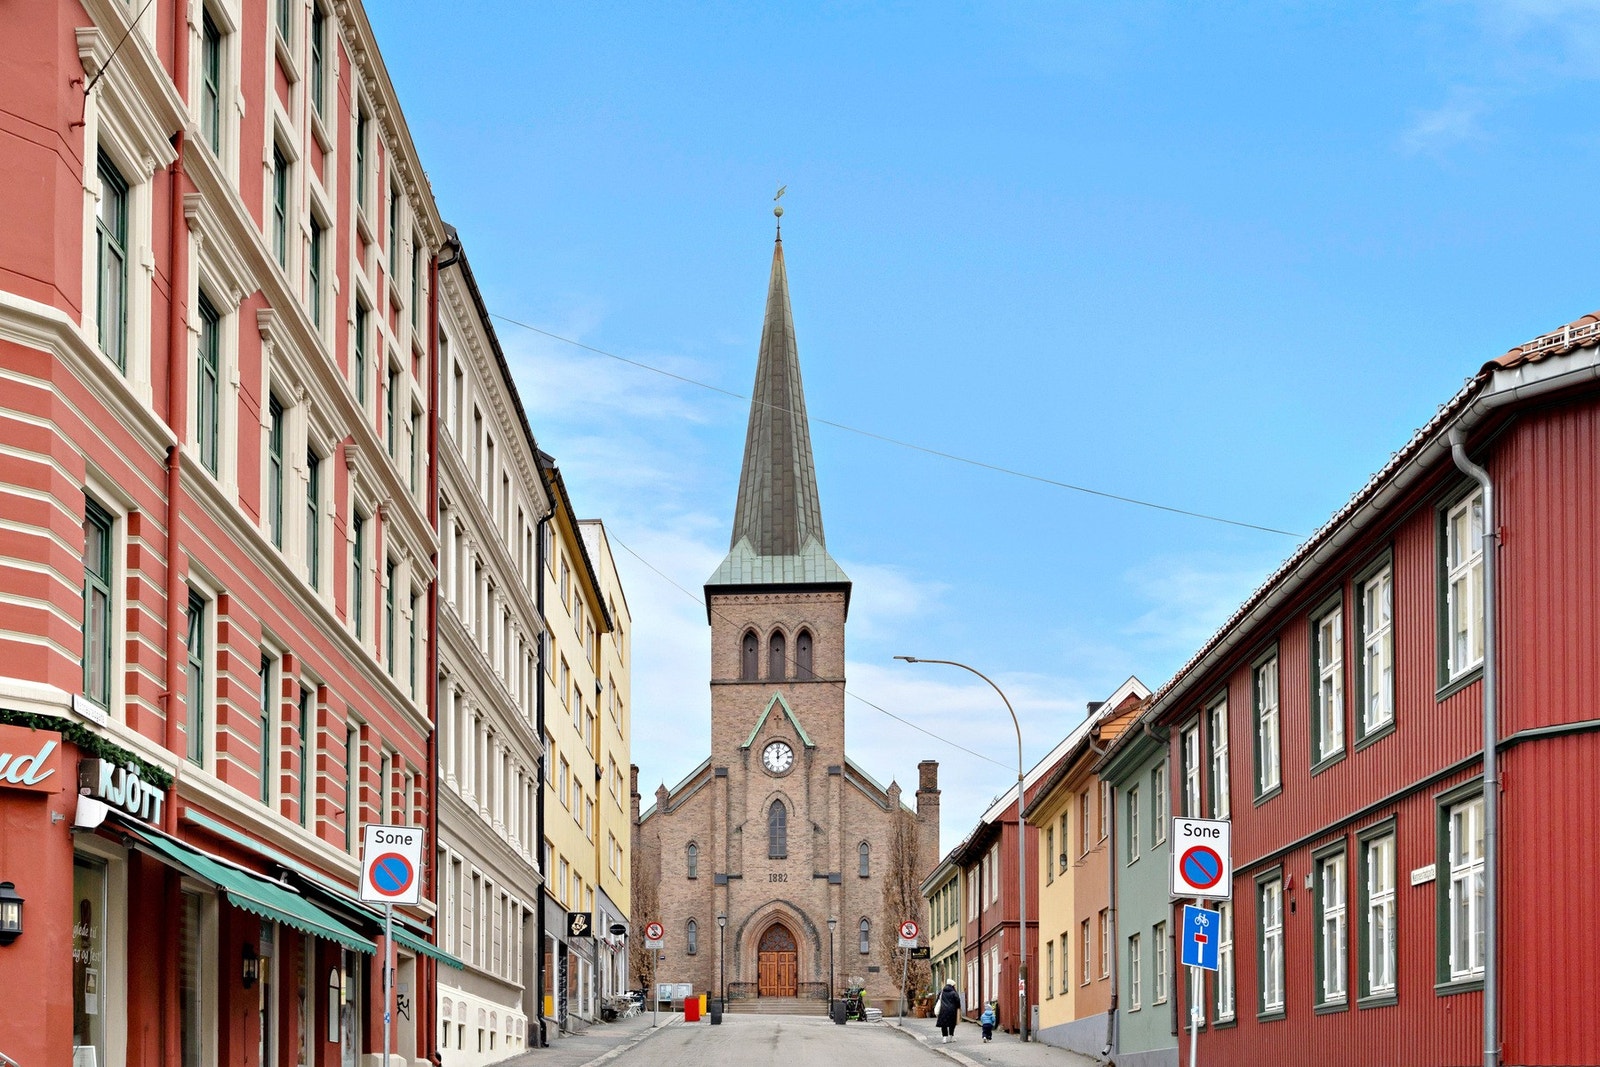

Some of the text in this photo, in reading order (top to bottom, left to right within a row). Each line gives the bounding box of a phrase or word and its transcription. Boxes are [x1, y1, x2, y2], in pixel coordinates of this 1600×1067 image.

[99, 758, 165, 825] KJÖTT
[375, 830, 413, 845] Sone
[1183, 823, 1220, 838] Sone
[768, 873, 788, 883] 1882
